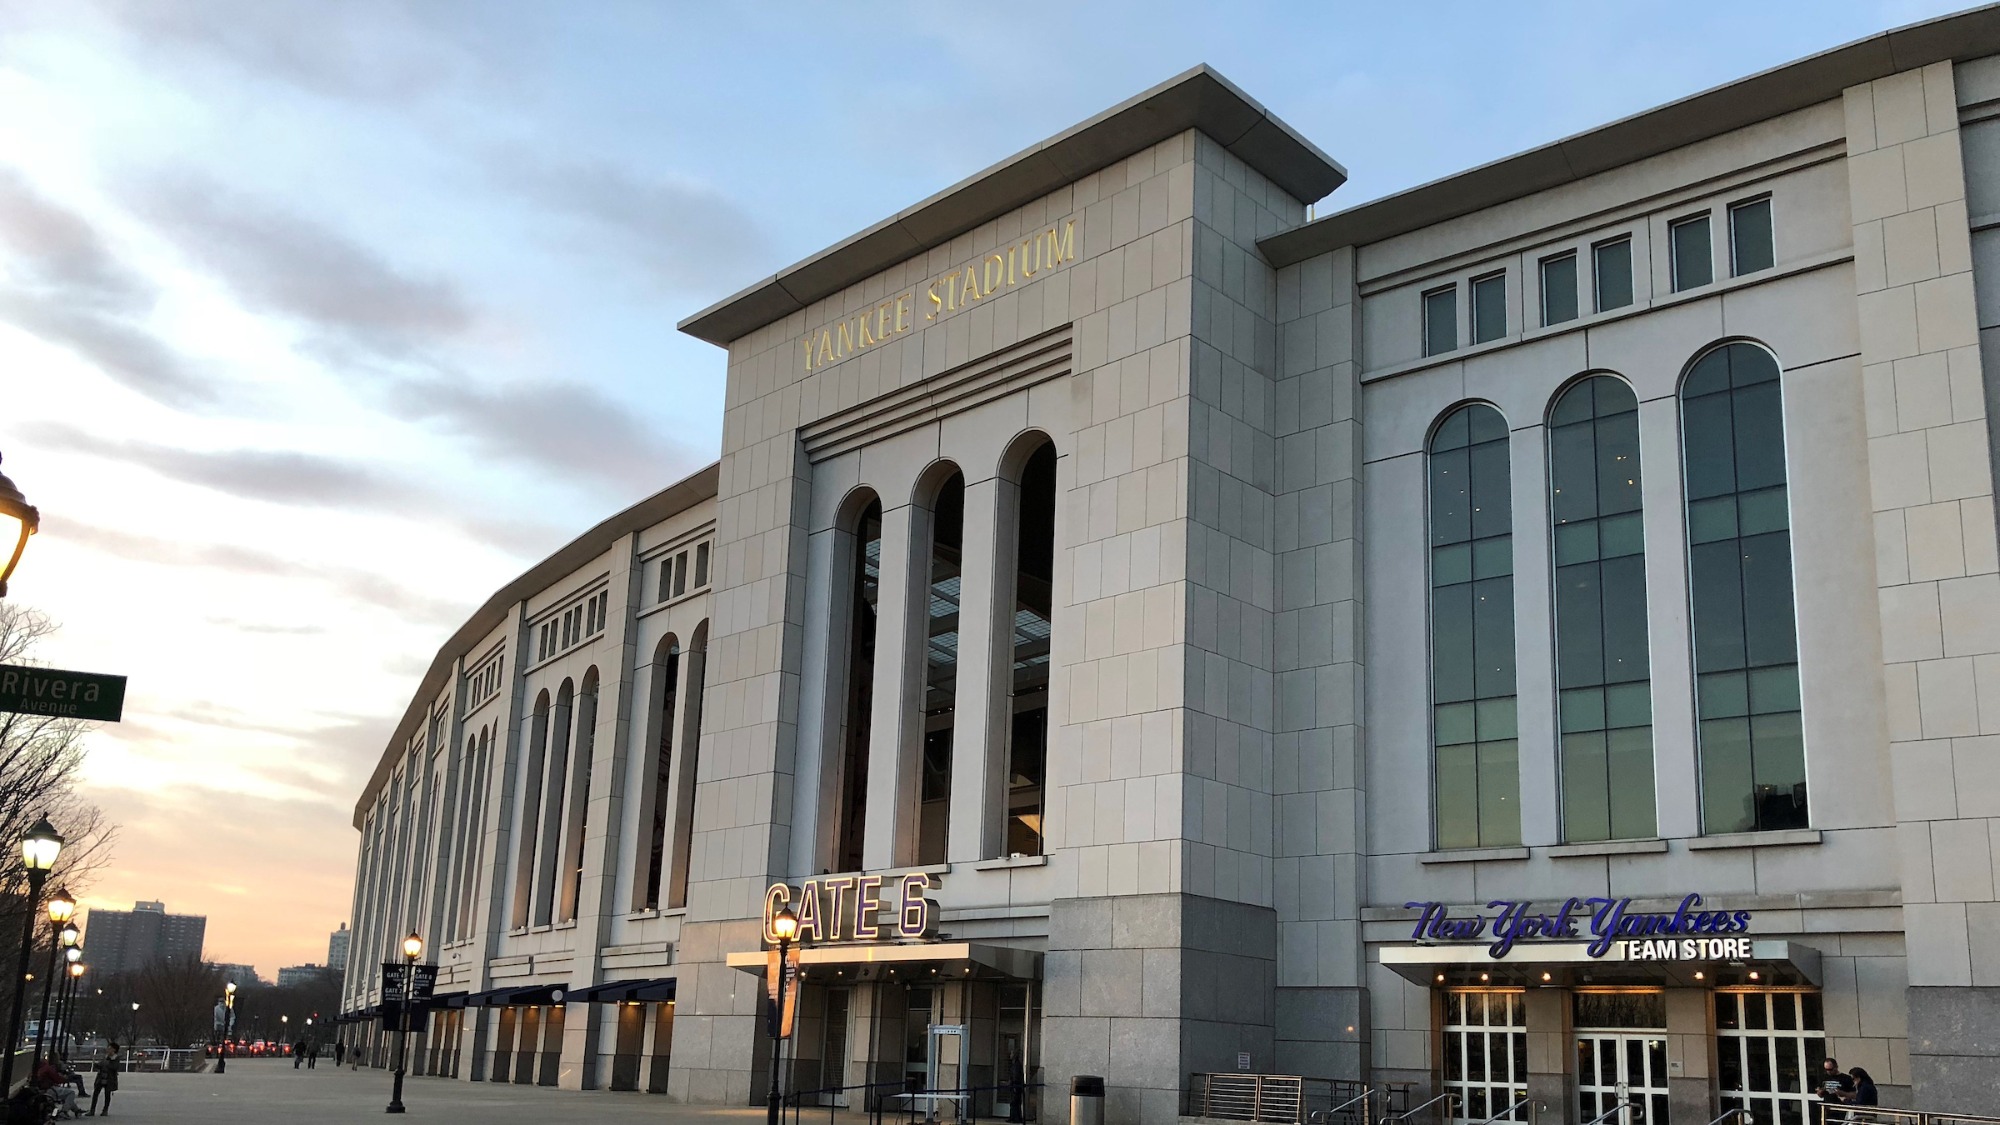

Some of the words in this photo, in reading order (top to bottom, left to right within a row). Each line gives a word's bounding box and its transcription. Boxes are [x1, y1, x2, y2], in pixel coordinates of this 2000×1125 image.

[803, 293, 911, 370] YANKEE
[926, 219, 1076, 320] STADIUM
[1, 670, 100, 702] Rivera
[20, 698, 77, 714] Avenue
[763, 875, 882, 944] GATE
[898, 872, 930, 938] 6
[1403, 901, 1486, 940] New
[1486, 896, 1583, 959] York
[1583, 892, 1752, 959] Yankees
[1617, 939, 1678, 960] TEAM
[1682, 937, 1751, 960] STORE
